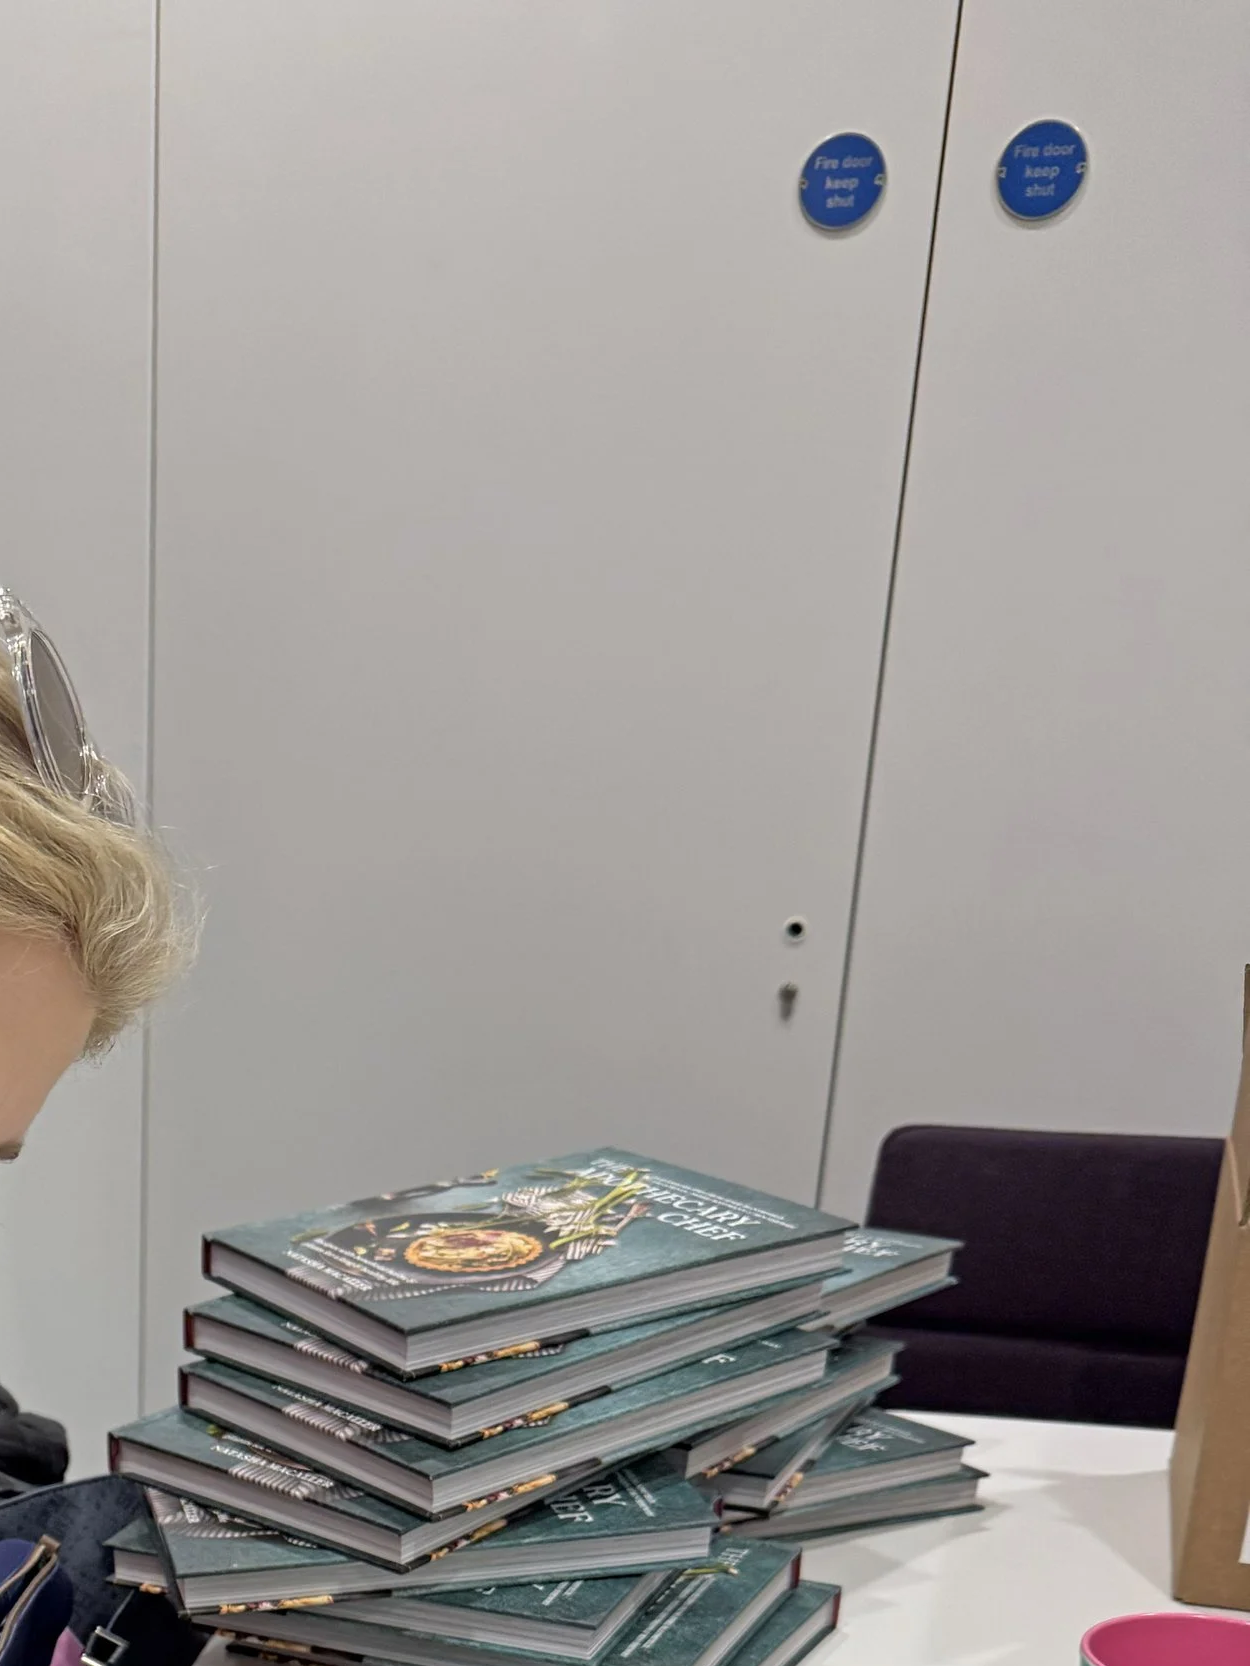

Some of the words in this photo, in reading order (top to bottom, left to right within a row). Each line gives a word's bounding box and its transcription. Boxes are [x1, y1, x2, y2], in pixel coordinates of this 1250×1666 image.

[1014, 143, 1039, 158] Fire
[1043, 143, 1076, 156] door
[813, 156, 839, 170] Fire
[842, 155, 874, 168] door
[1025, 165, 1060, 180] keep
[825, 176, 859, 191] keep
[1025, 183, 1055, 197] shut
[826, 194, 855, 208] shut
[657, 1212, 747, 1241] CHEF
